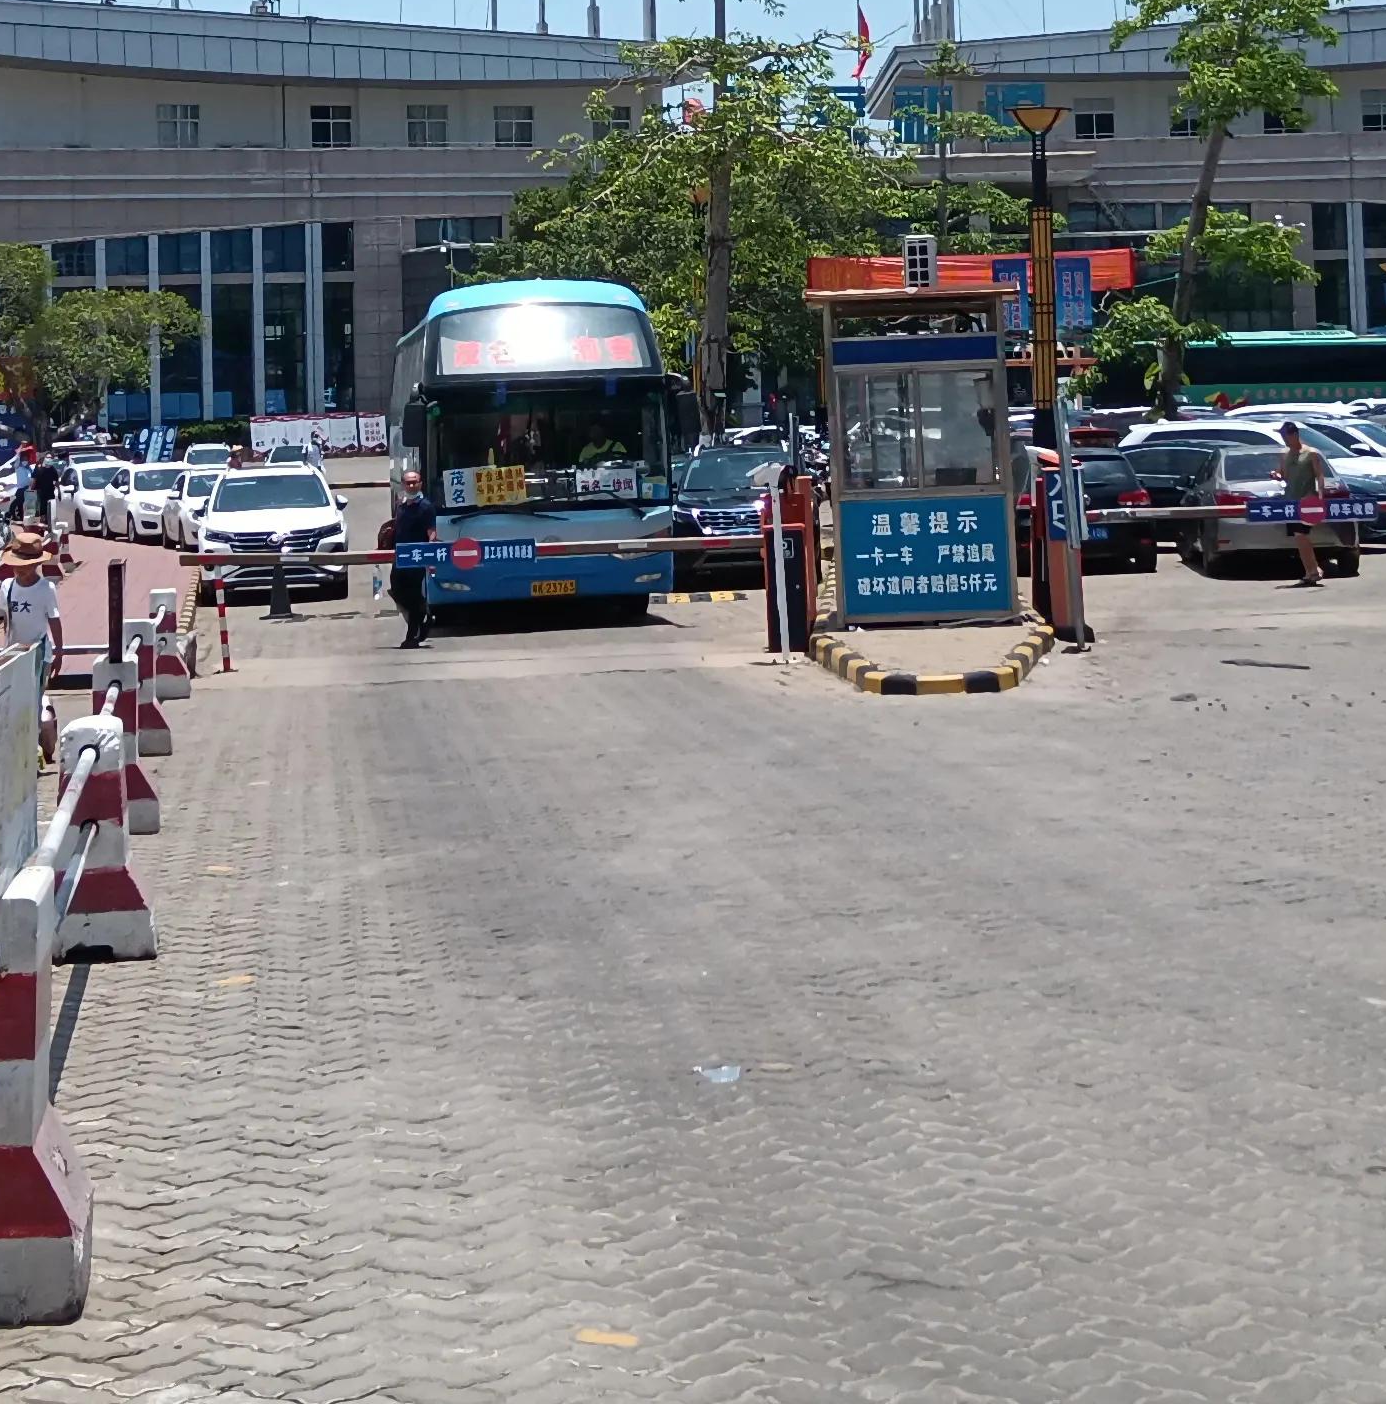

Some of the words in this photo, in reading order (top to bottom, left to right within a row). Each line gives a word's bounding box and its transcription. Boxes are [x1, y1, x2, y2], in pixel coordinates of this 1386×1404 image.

[449, 469, 466, 505] 茂名
[1329, 502, 1374, 516] 停车收费
[871, 510, 978, 536] 温馨提示
[855, 546, 914, 567] 一卡一车
[937, 543, 996, 564] 严禁追尾
[857, 572, 998, 596] 碰坏道闸者赔偿5仟元
